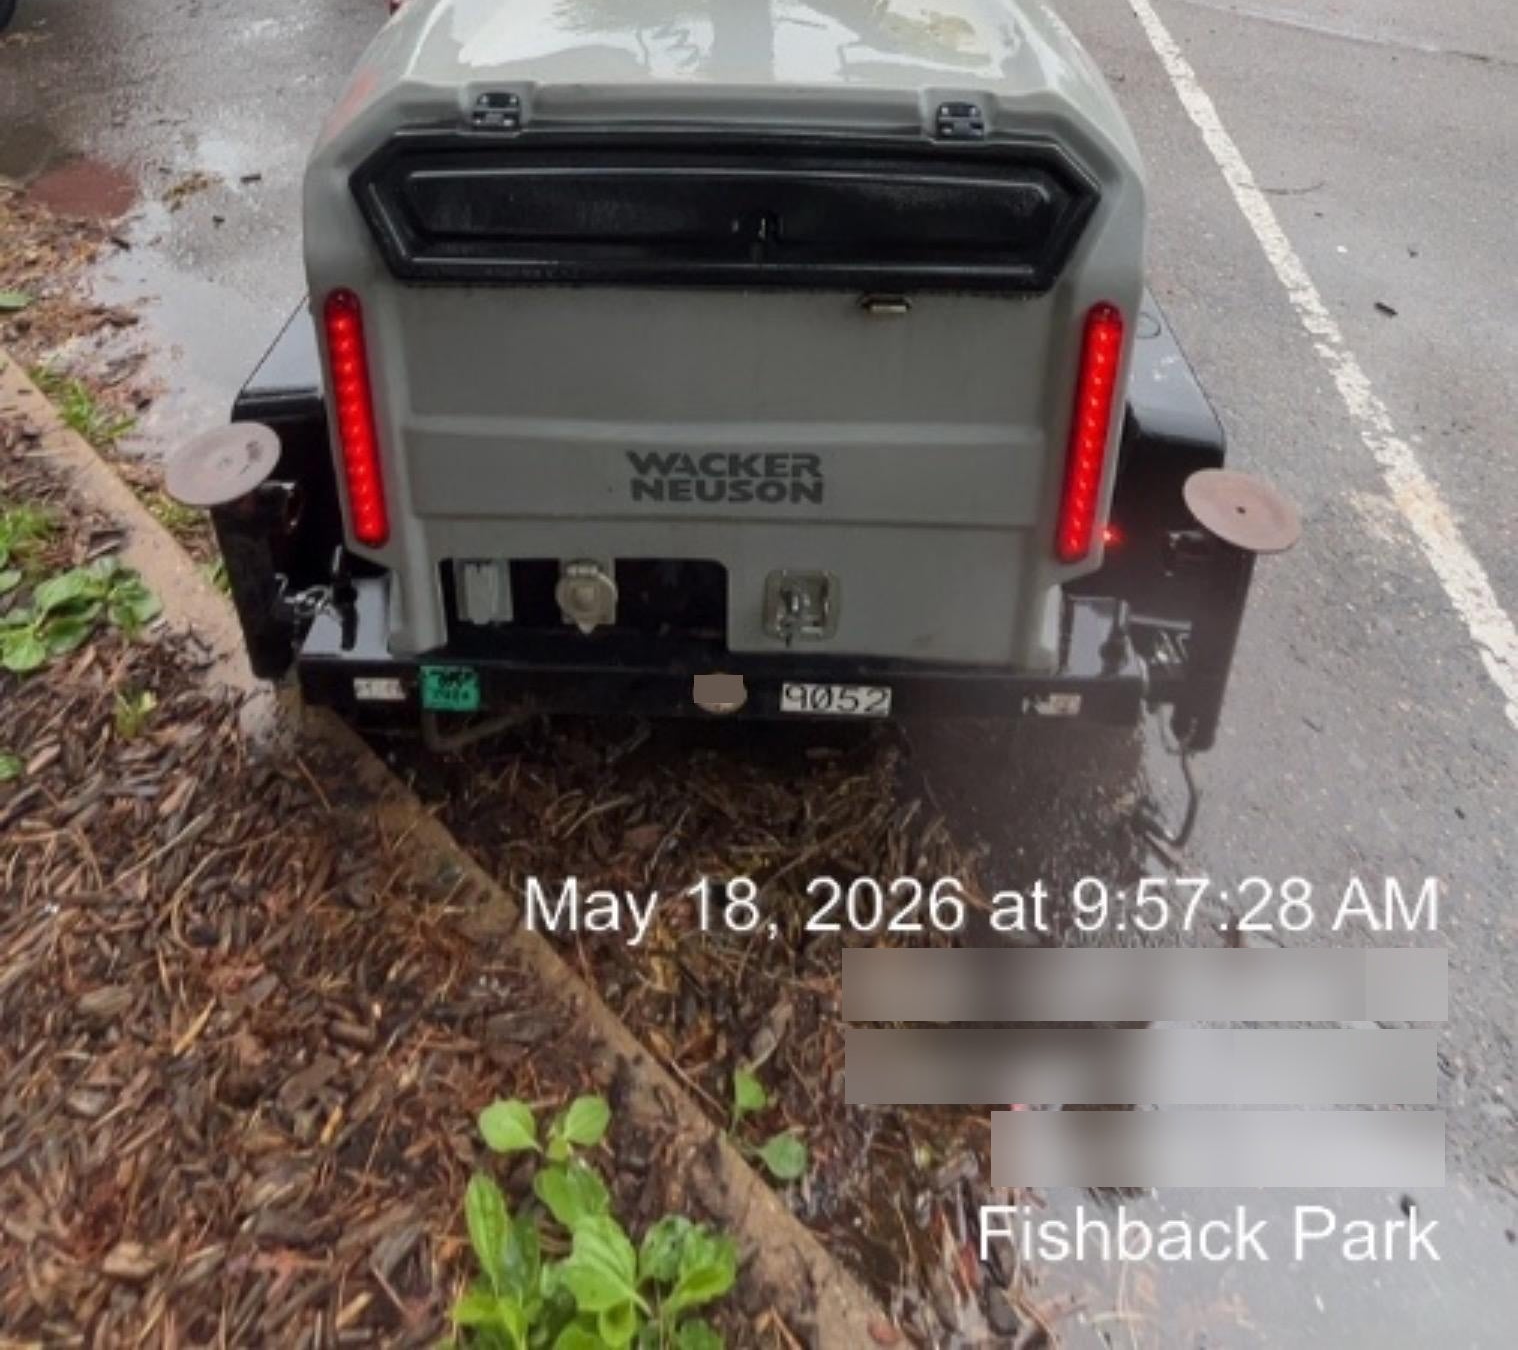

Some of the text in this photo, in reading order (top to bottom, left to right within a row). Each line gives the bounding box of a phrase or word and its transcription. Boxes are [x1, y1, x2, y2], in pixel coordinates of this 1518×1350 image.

[626, 450, 823, 478] WACKER
[631, 478, 824, 505] NEUSON
[782, 682, 890, 715] 9052
